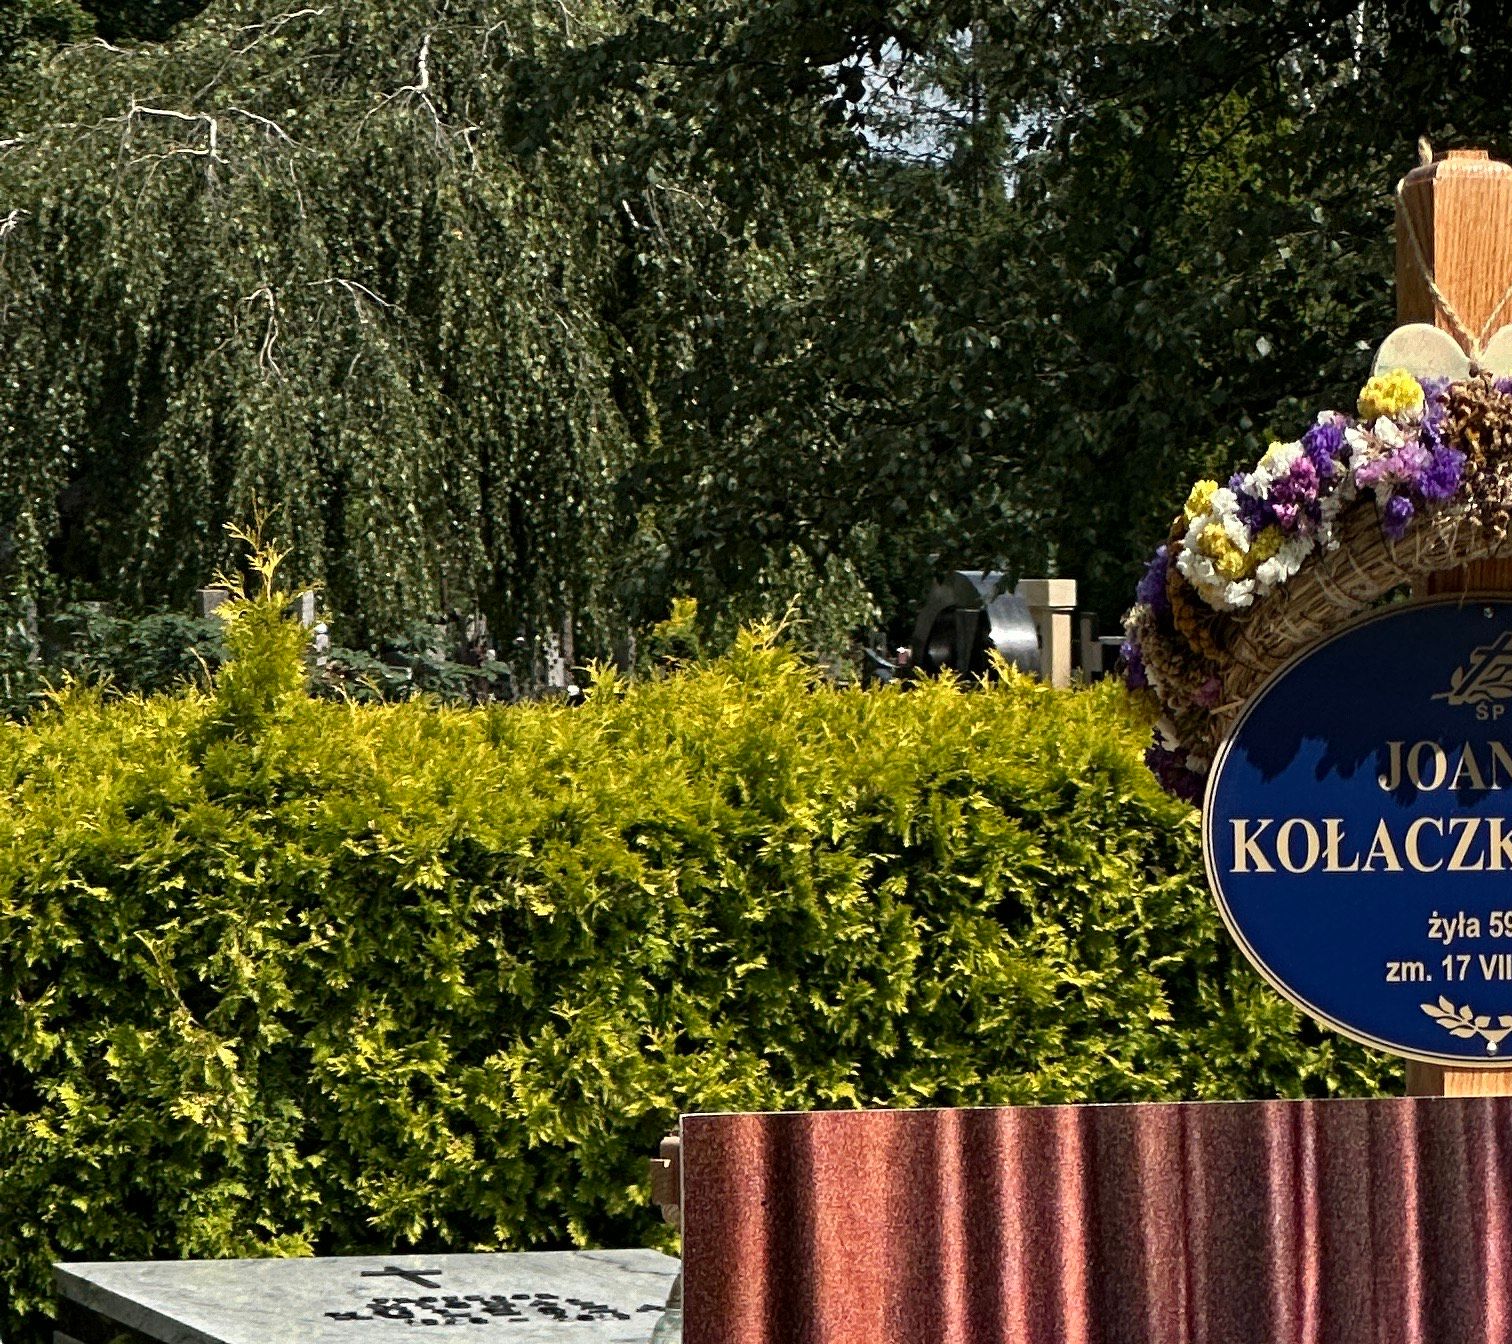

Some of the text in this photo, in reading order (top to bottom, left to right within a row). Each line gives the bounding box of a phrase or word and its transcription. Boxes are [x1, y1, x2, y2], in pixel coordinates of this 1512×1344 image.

[1428, 911, 1481, 945] żyła
[1385, 962, 1433, 983] zm.
[1442, 956, 1469, 981] 17
[1479, 955, 1512, 981] VII
